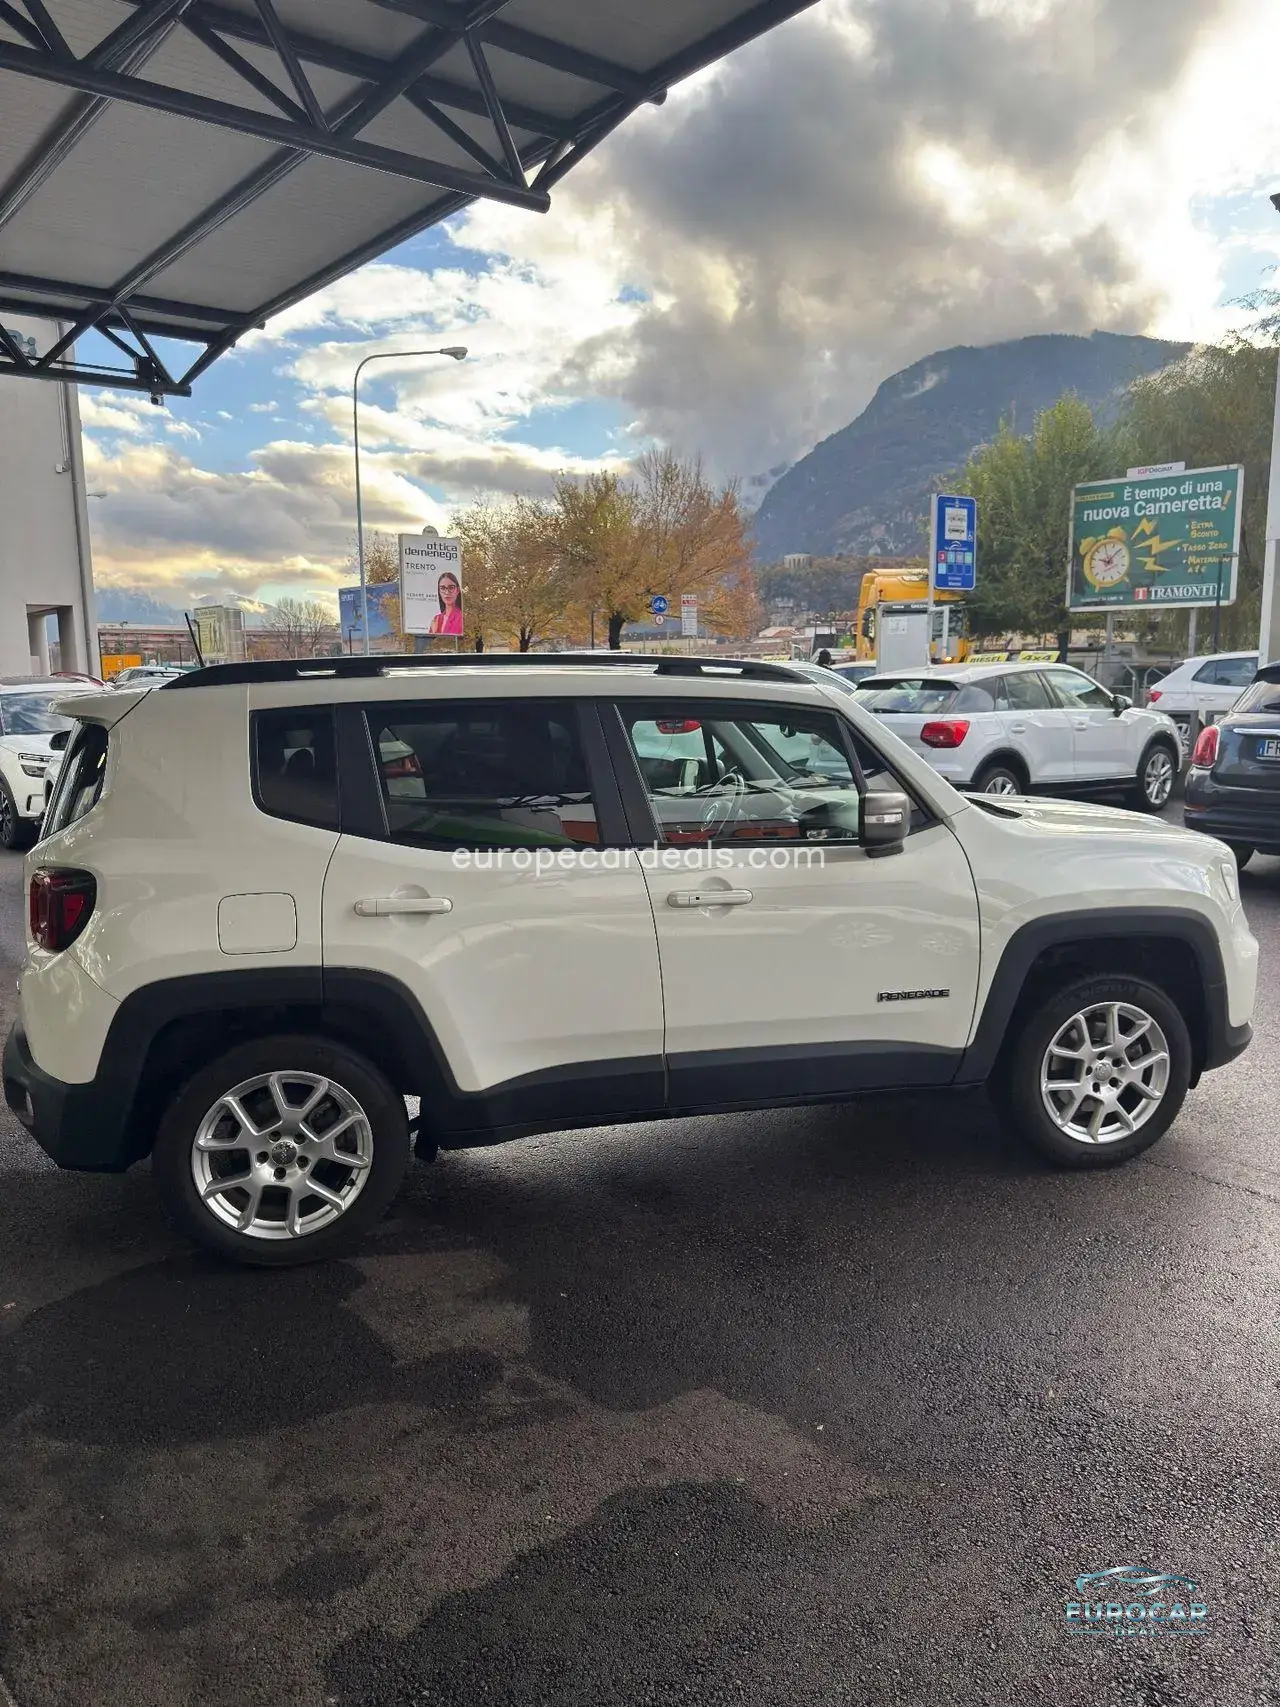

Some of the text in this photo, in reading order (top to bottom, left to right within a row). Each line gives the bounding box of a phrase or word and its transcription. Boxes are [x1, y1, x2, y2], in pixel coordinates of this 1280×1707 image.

[1123, 486, 1132, 501] È
[1135, 485, 1177, 500] tempo
[1180, 481, 1193, 493] di
[1197, 480, 1222, 493] una
[1083, 490, 1232, 522] nuova Cameretta!
[404, 547, 458, 560] demenego
[427, 542, 458, 552] ottica
[406, 562, 436, 571] TRENTO
[878, 989, 950, 1002] RENEGADE
